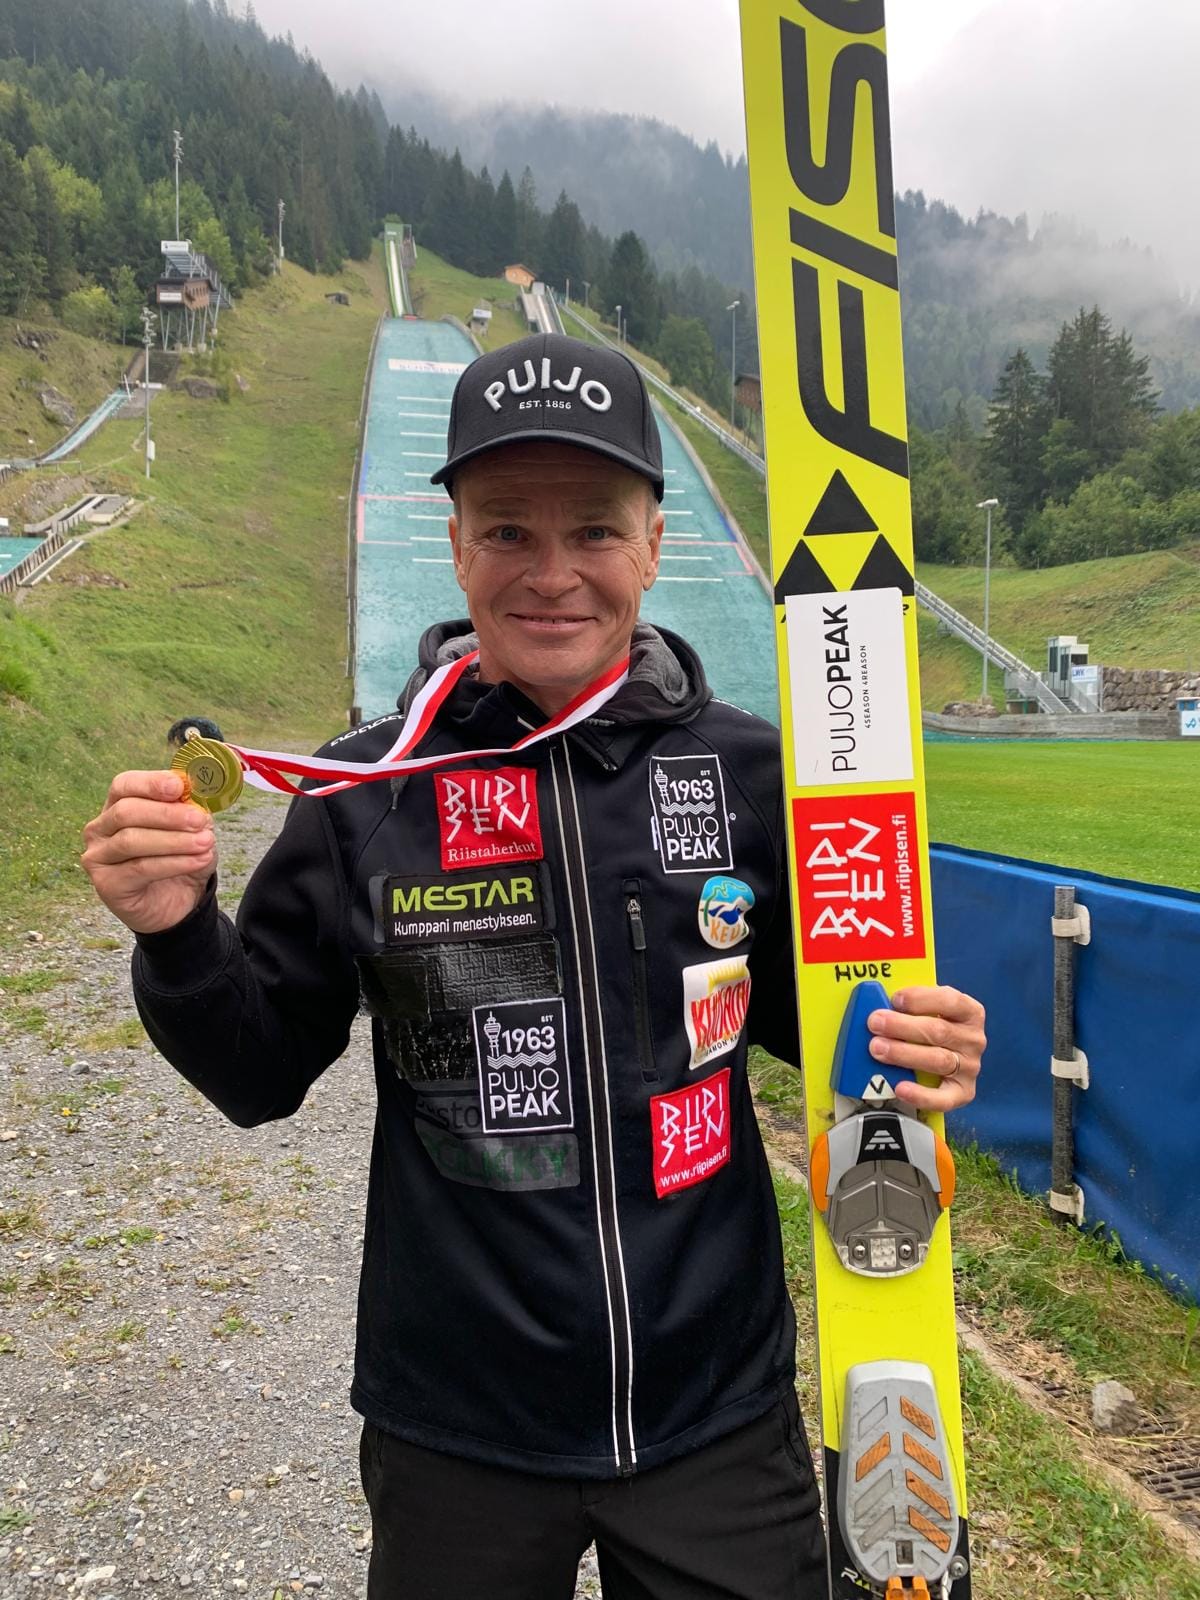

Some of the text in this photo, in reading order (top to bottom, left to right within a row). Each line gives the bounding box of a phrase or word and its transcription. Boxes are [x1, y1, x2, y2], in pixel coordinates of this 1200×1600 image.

[780, 0, 909, 479] FIS
[483, 357, 613, 413] PUIJO
[519, 399, 572, 410] EST. 1856
[669, 779, 715, 802] 1963
[662, 816, 720, 838] PUIJO
[447, 841, 537, 862] Riistaherkut
[666, 836, 723, 861] PEAK
[892, 814, 914, 937] www.riipisen.fi
[392, 877, 534, 914] MESTAR
[394, 912, 537, 938] Kumppani menestykseen.
[501, 1025, 556, 1053] 1963
[487, 1067, 560, 1095] PUIJO
[489, 1089, 562, 1119] PEAK
[660, 1145, 728, 1188] www.riipisen.fi
